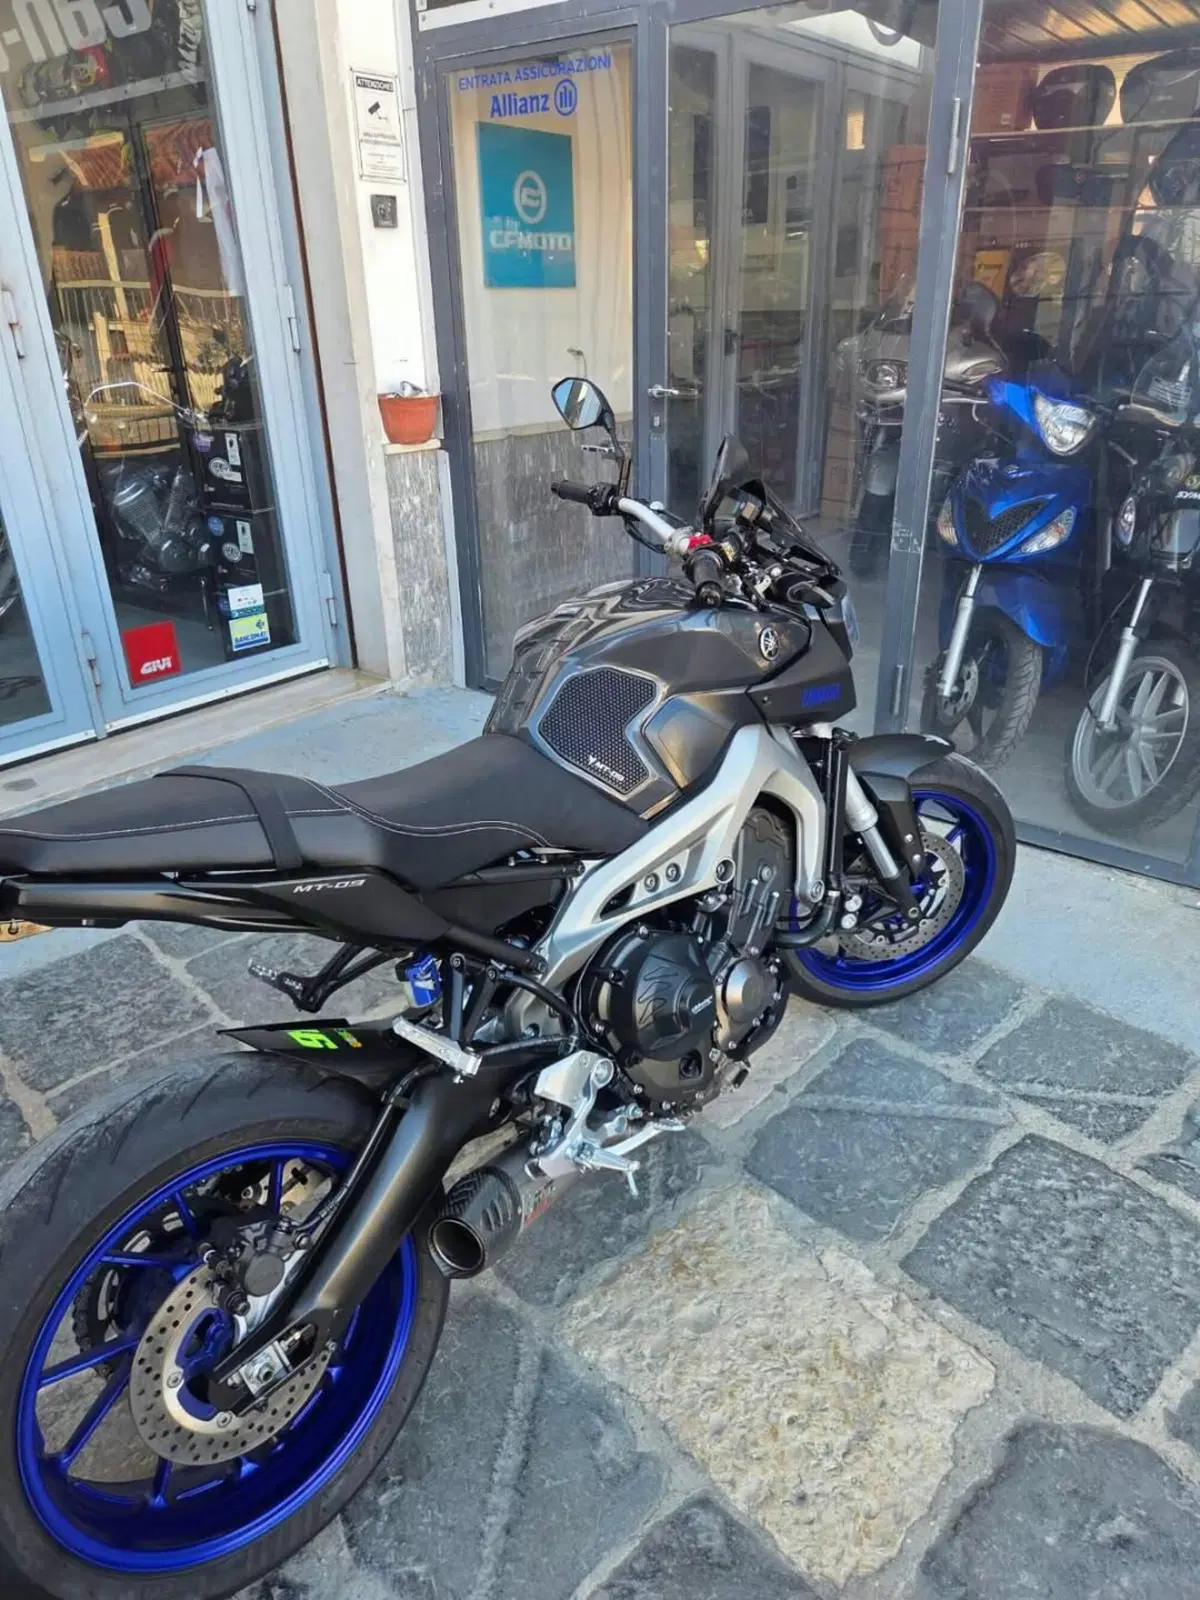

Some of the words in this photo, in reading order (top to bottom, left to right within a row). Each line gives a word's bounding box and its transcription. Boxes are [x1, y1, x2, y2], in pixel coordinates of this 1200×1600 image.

[458, 71, 512, 90] ENTRATA
[490, 92, 550, 118] Allianz
[140, 656, 172, 674] GIVI
[293, 879, 366, 893] MT-09
